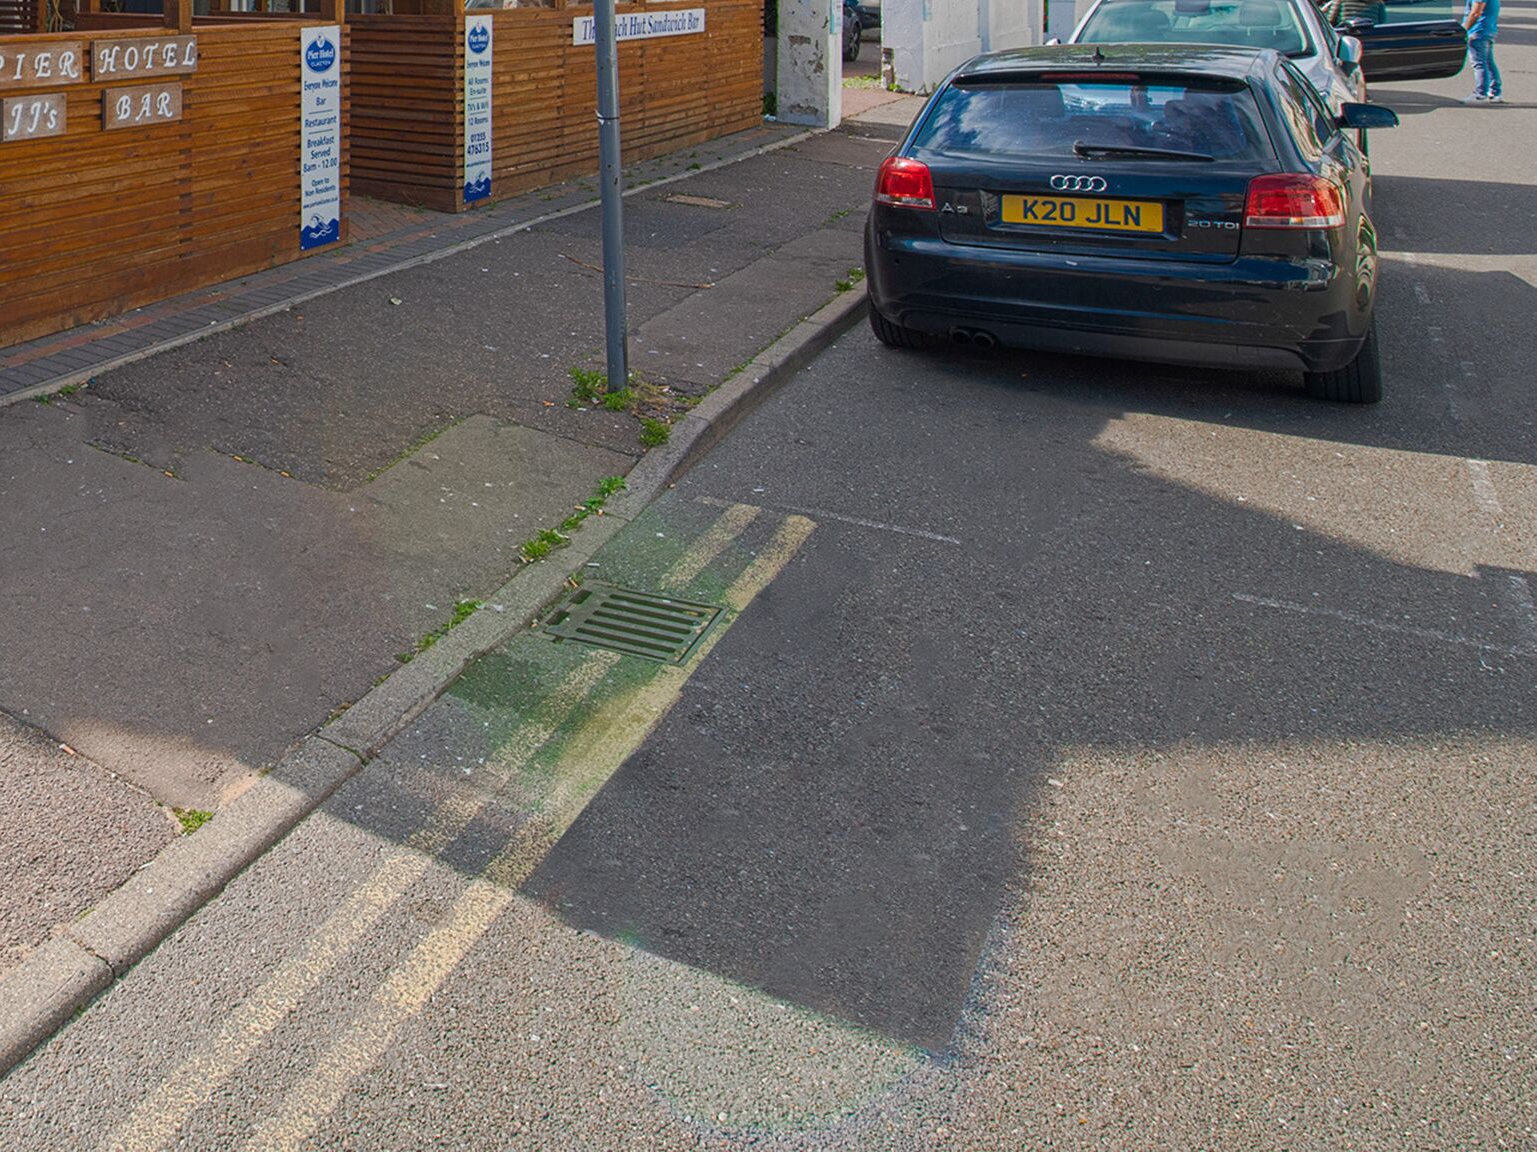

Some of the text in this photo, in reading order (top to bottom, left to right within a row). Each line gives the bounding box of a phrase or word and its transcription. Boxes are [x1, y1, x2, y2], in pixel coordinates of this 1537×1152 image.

[629, 16, 646, 36] Hut
[648, 12, 686, 35] Sandwich
[687, 12, 699, 31] Bar
[99, 41, 196, 74] HOTEL
[116, 92, 173, 121] BAR
[316, 96, 326, 106] Bar
[304, 115, 337, 128] Restaurant
[307, 135, 335, 148] Breakfast
[311, 147, 331, 159] Served
[941, 202, 968, 214] A3
[1023, 199, 1141, 228] K20 JLN
[1214, 221, 1239, 230] TDI
